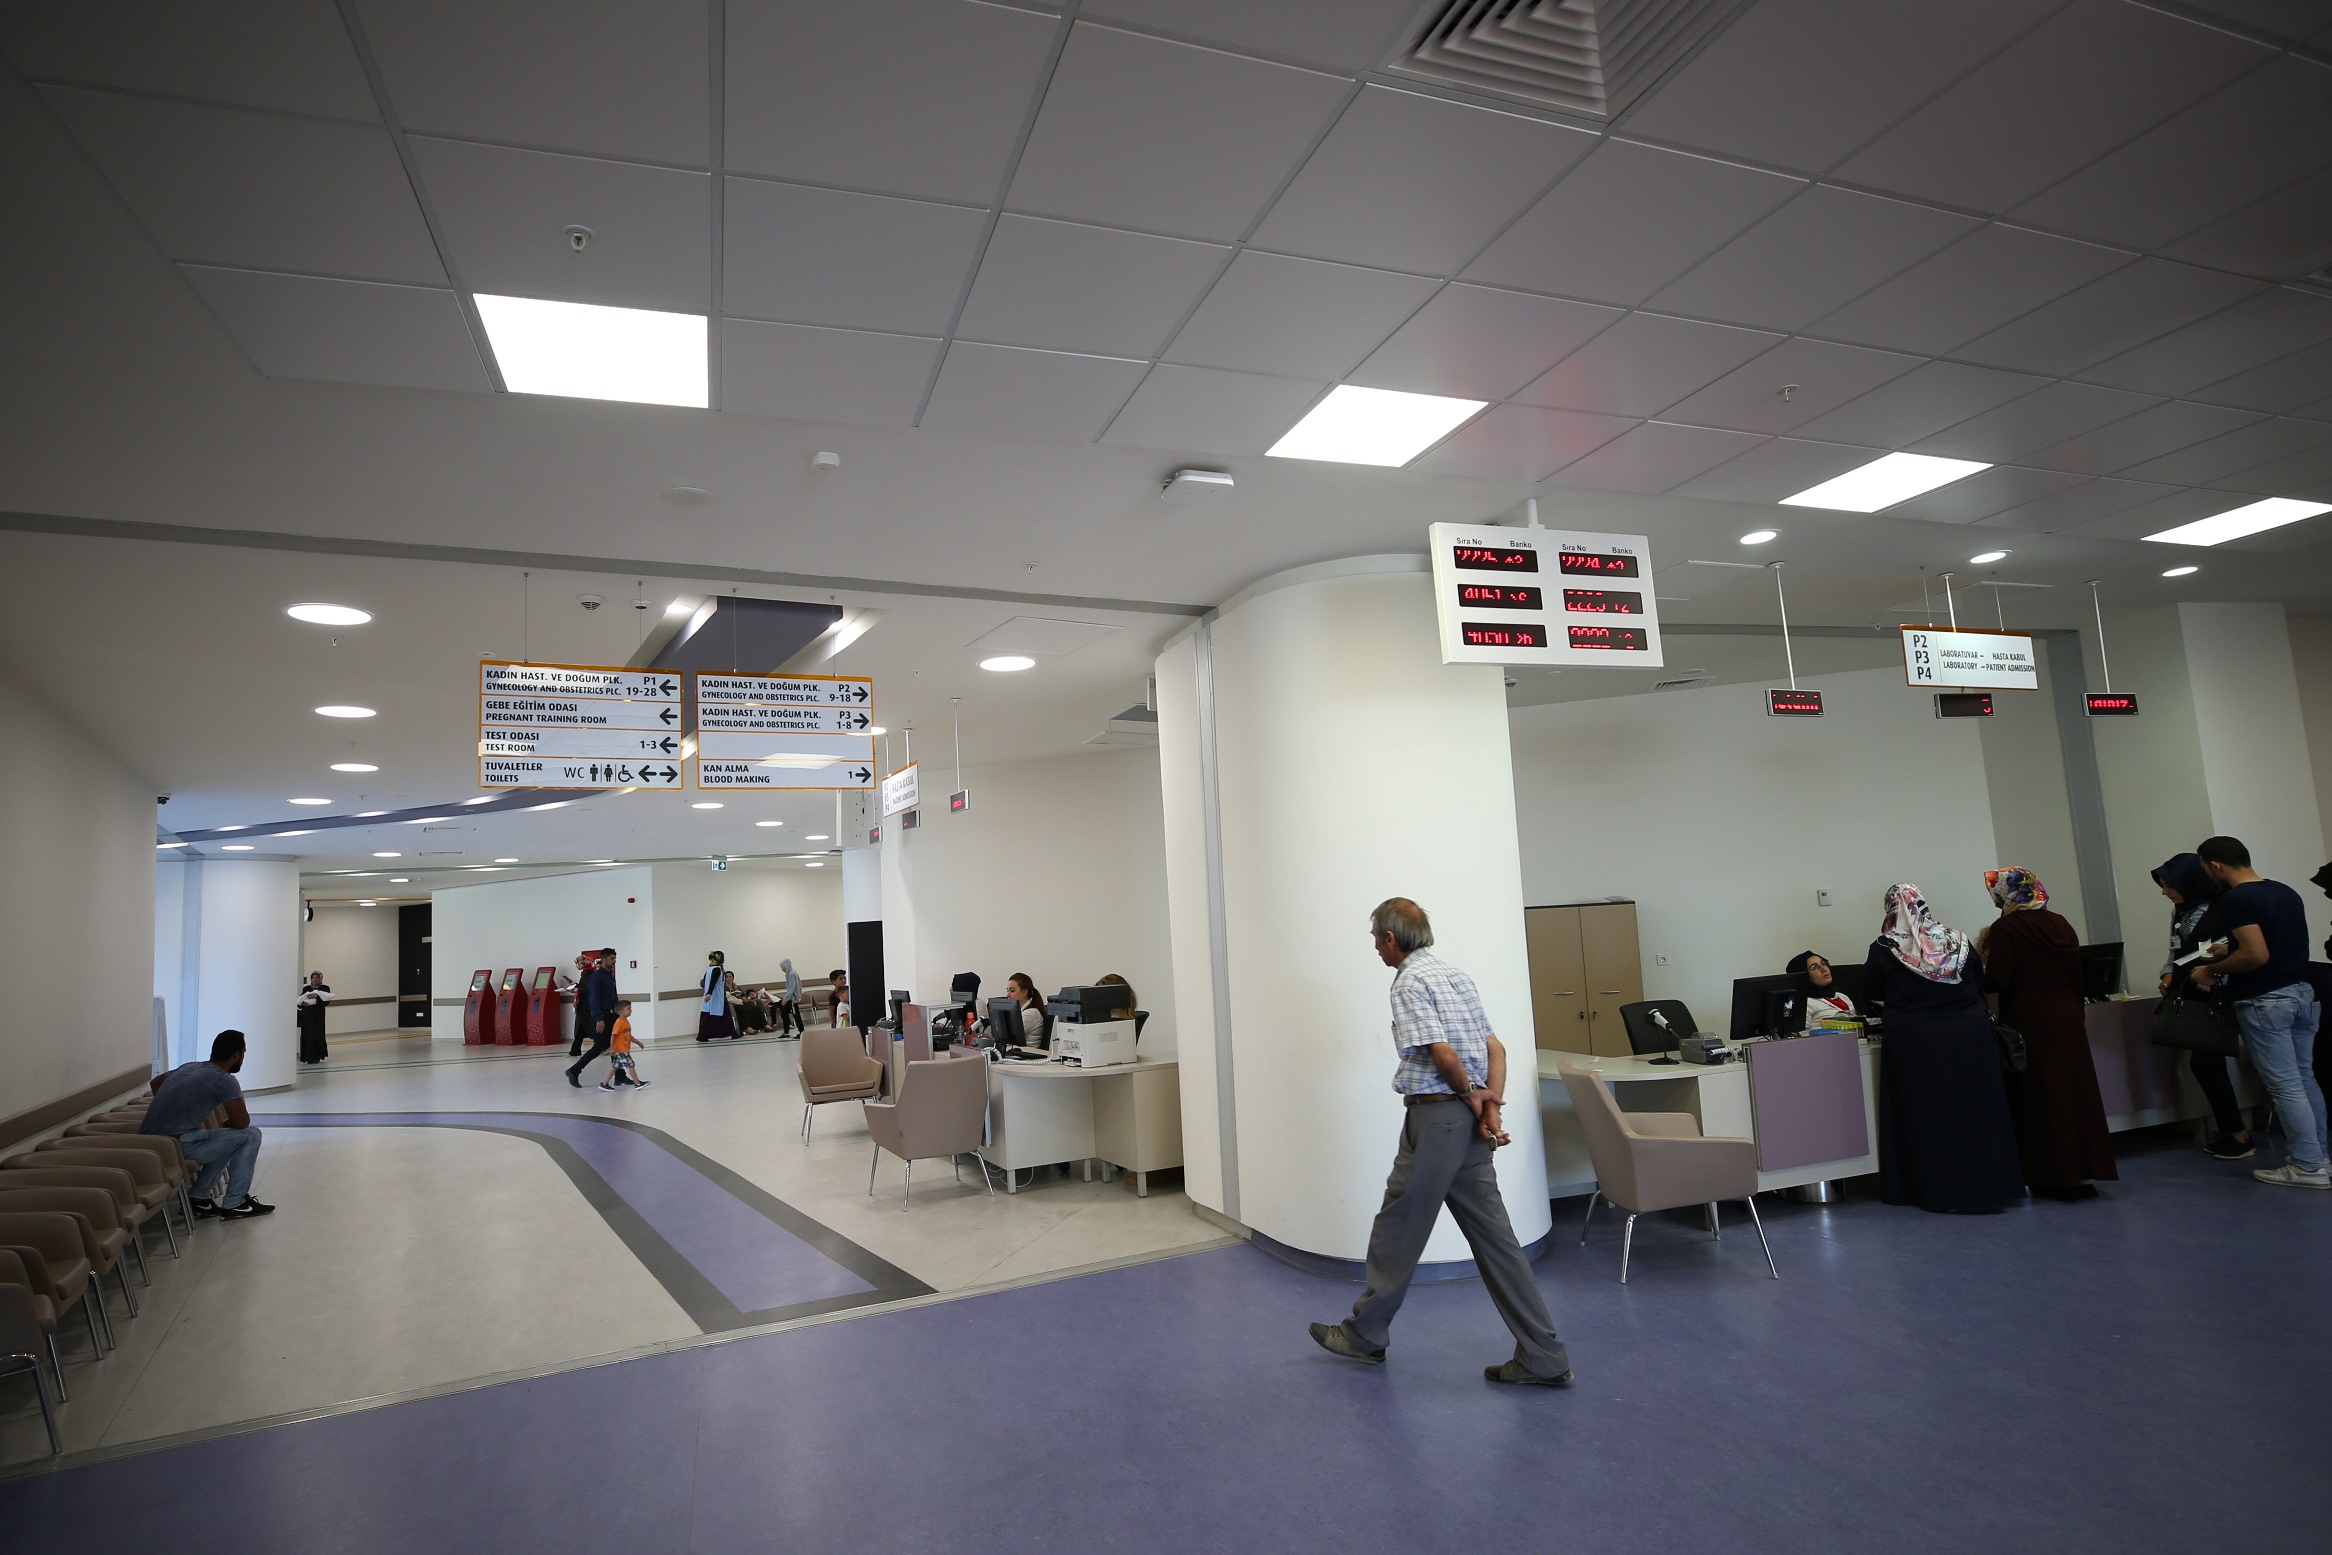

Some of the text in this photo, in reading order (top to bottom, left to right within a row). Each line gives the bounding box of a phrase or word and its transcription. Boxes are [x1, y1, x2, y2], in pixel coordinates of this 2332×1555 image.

[1913, 634, 1928, 648] P2
[1915, 650, 1930, 664] P3
[1940, 649, 1978, 659] LABORATUVAR
[1943, 661, 1977, 670] LABORATORY
[486, 670, 623, 684] KADIN HAST. VE DOĞUM PLK.
[1917, 666, 1932, 680] P4
[643, 677, 656, 685] P1
[486, 683, 537, 691] GYNECOLOGY
[540, 684, 557, 692] AND
[559, 686, 603, 694] OBSTETRICS
[702, 680, 729, 688] KADIN
[758, 682, 767, 690] VE
[770, 681, 800, 691] DOĞUM
[803, 684, 820, 692] PLK.
[626, 687, 657, 696] 19-28
[702, 691, 746, 700] GYNECOLOGY
[766, 694, 803, 702] OBSTETRICS
[830, 694, 851, 702] 9-18
[486, 700, 577, 711] GEBE EĞİTİM ODASI
[702, 708, 729, 717] KADIN
[771, 709, 801, 718] DOĞUM
[804, 711, 821, 719] PLK.
[839, 711, 851, 719] P3
[486, 713, 607, 724] PREGNANT TRAINING ROOM
[702, 720, 747, 728] GYNECOLOGY
[766, 721, 804, 729] OBSTETRICS
[836, 722, 851, 730] 1-8
[486, 731, 539, 740] TEST ODASI
[640, 741, 657, 749] 1-3
[485, 762, 543, 771] TUVALETLER
[564, 767, 585, 778] WC
[848, 771, 852, 779] 1
[485, 774, 519, 782] TOILETS
